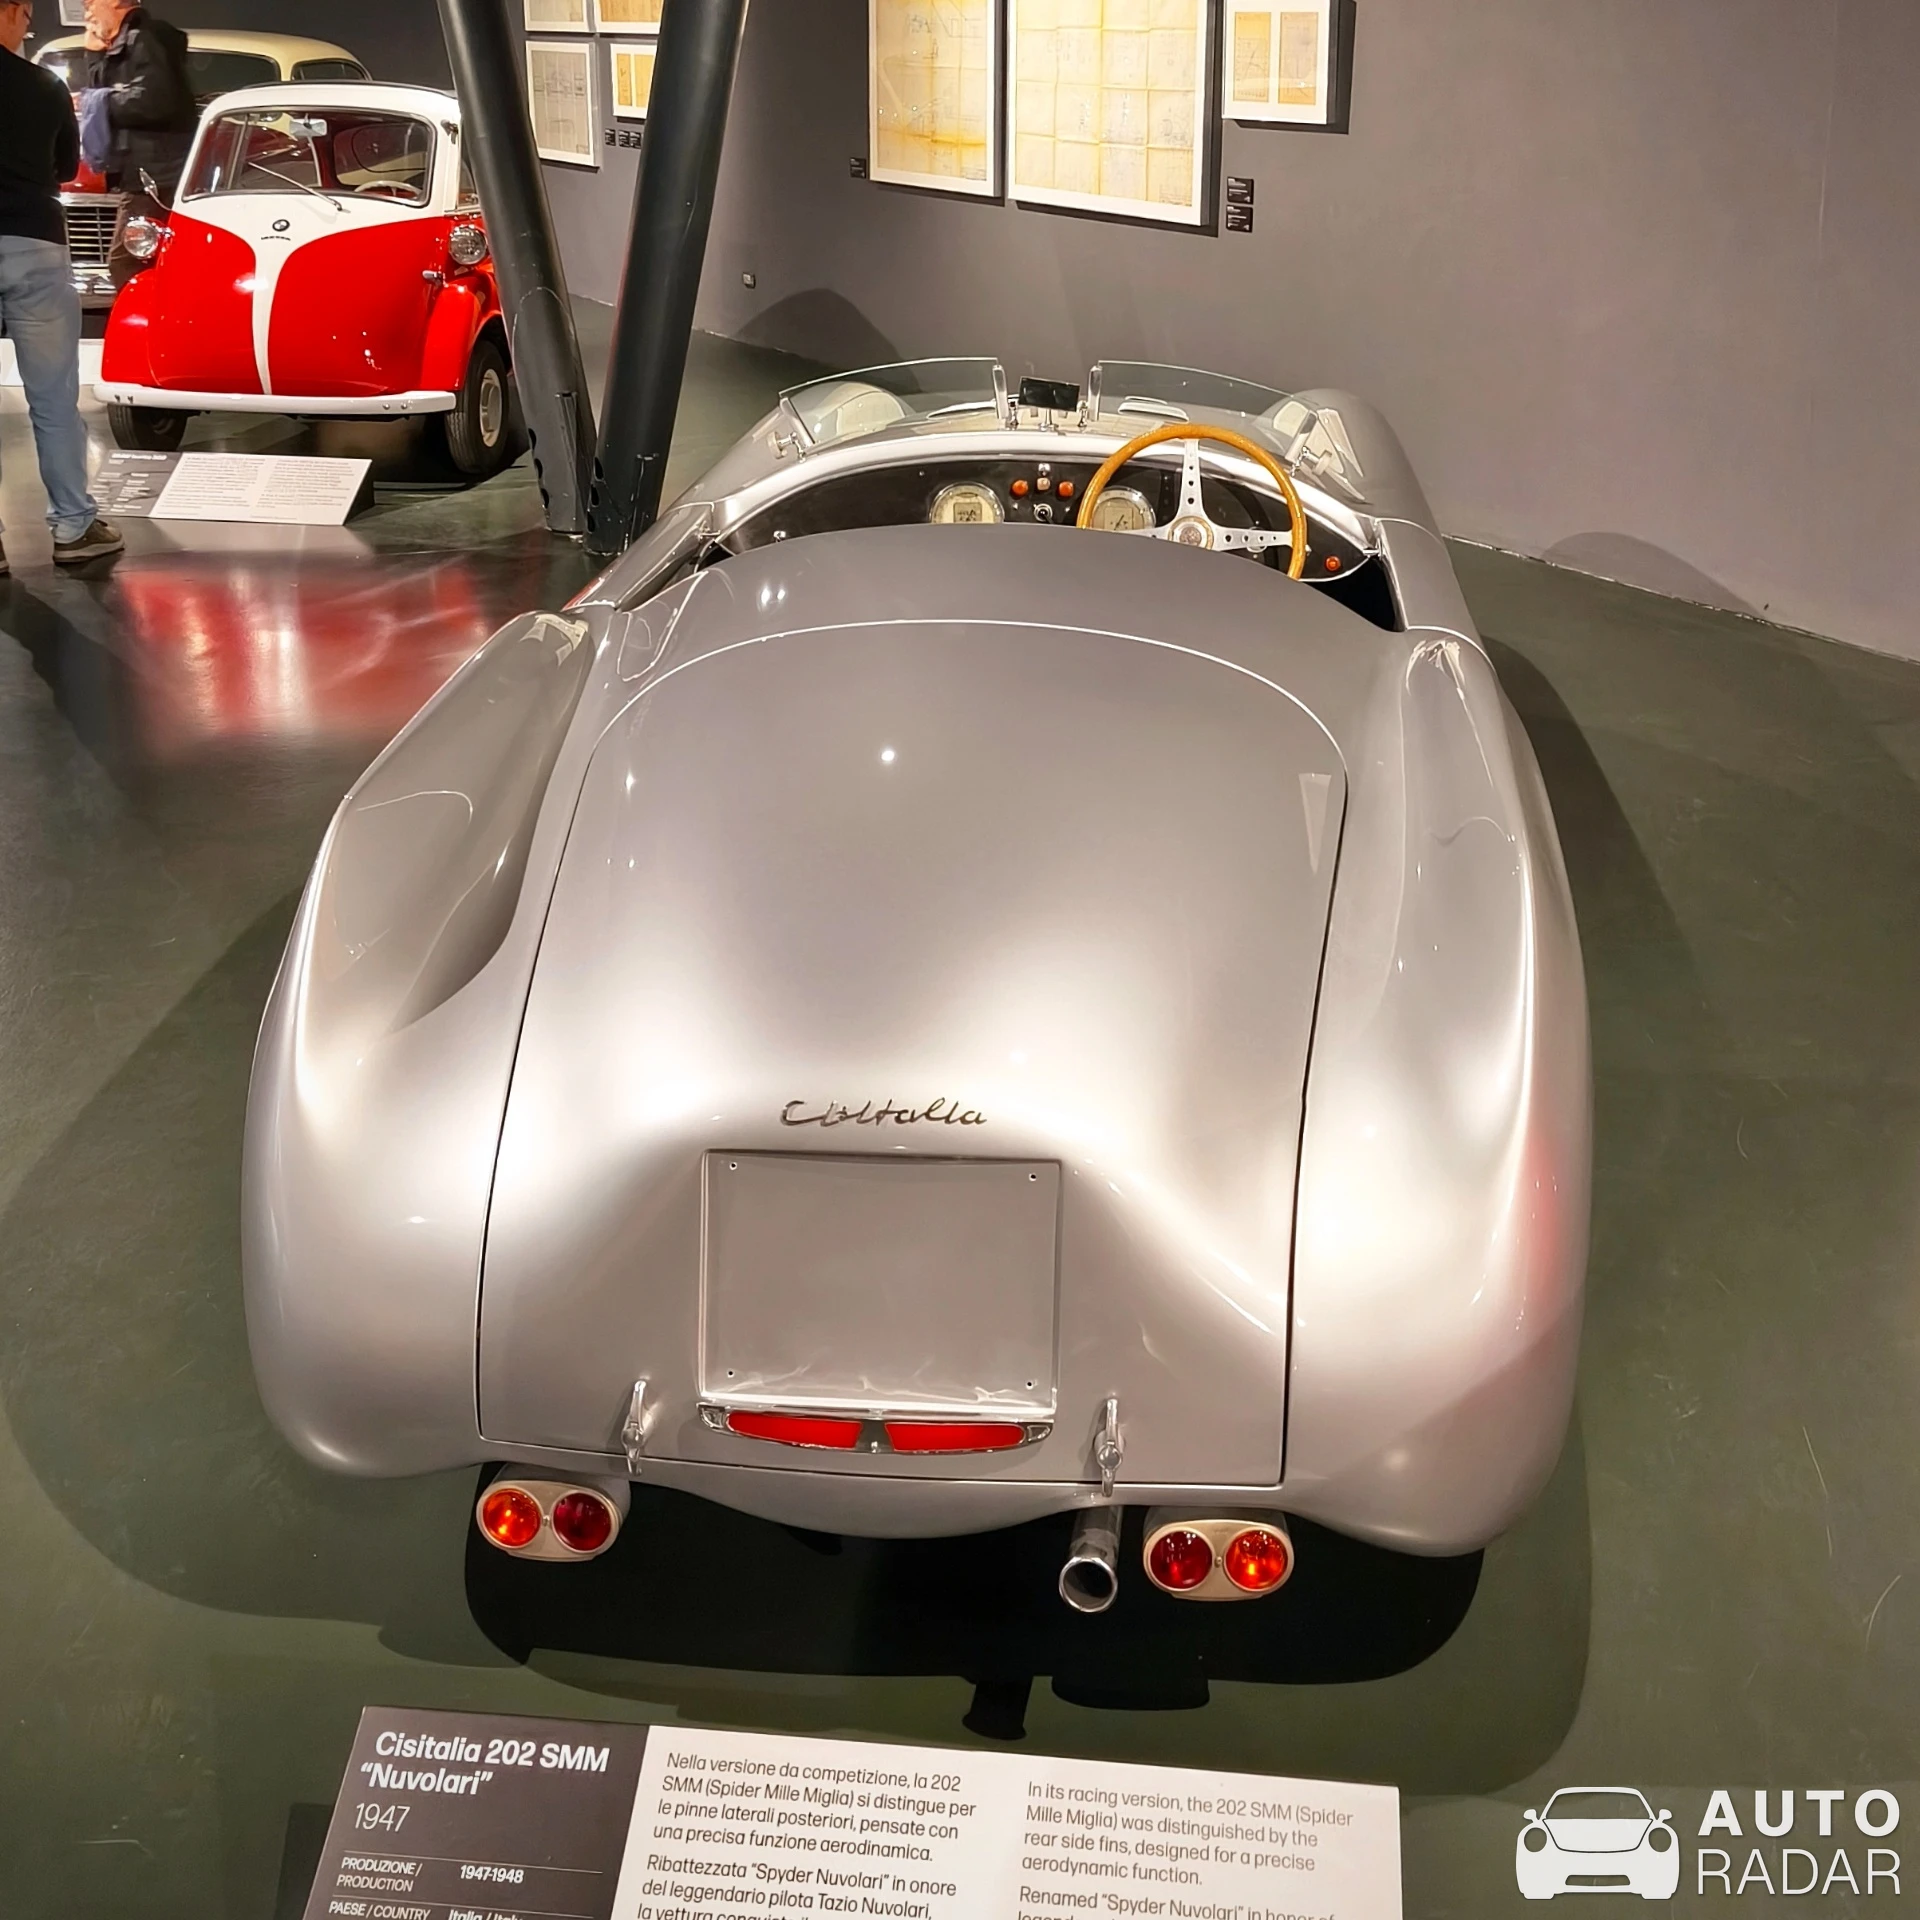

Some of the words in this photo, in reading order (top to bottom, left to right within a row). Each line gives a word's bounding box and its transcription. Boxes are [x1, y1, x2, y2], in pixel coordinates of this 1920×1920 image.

[376, 1731, 482, 1763] Cisitalia
[484, 1739, 536, 1767] 202
[539, 1743, 610, 1772] SMM
[360, 1762, 494, 1795] “Nuvolari”
[667, 1752, 706, 1770] Nella
[710, 1758, 776, 1776] versione
[779, 1762, 799, 1778] da
[802, 1767, 910, 1789] competizione,
[914, 1772, 927, 1789] la
[931, 1774, 961, 1792] 202
[662, 1775, 703, 1793] SMM
[705, 1778, 762, 1798] (Spider
[764, 1783, 800, 1801] Mille
[803, 1786, 854, 1808] Miglia)
[857, 1792, 870, 1807] si
[873, 1793, 946, 1816] distingue
[949, 1803, 977, 1818] per
[1027, 1781, 1042, 1797] In
[1045, 1783, 1065, 1800] its
[1068, 1787, 1118, 1808] racing
[1121, 1792, 1183, 1813] version,
[1187, 1796, 1213, 1813] the
[1216, 1798, 1247, 1816] 202
[1250, 1801, 1292, 1820] SMM
[1295, 1805, 1353, 1827] (Spider
[354, 1802, 410, 1832] 1947
[658, 1799, 672, 1814] le
[674, 1801, 718, 1819] pinne
[721, 1803, 775, 1823] laterali
[777, 1812, 856, 1832] posteriori,
[859, 1818, 925, 1836] pensate
[929, 1824, 959, 1839] con
[1026, 1804, 1062, 1823] Mille
[1066, 1808, 1118, 1831] Miglia)
[1121, 1817, 1154, 1832] was
[1157, 1817, 1265, 1842] distinguished
[1269, 1827, 1288, 1848] by
[1292, 1830, 1318, 1847] the
[653, 1825, 683, 1840] una
[685, 1828, 745, 1845] precisa
[749, 1830, 817, 1851] funzione
[820, 1838, 933, 1861] aerodinamica.
[1024, 1831, 1058, 1847] rear
[1061, 1833, 1095, 1851] side
[1099, 1835, 1132, 1856] fins,
[1135, 1839, 1210, 1862] designed
[1214, 1846, 1237, 1863] for
[1240, 1852, 1250, 1865] a
[1254, 1853, 1315, 1871] precise
[336, 1874, 414, 1892] PRODUCTION
[460, 1864, 524, 1884] 1947-1948
[647, 1854, 747, 1878] Ribattezzata
[751, 1862, 813, 1885] “Spyder
[816, 1868, 889, 1890] Nuvolari”
[892, 1875, 906, 1892] in
[909, 1880, 957, 1897] onore
[1022, 1856, 1128, 1878] aerodynamic
[1132, 1862, 1203, 1886] function.
[637, 1902, 652, 1920] la
[642, 1879, 668, 1896] del
[669, 1880, 766, 1905] leggendario
[768, 1889, 814, 1909] pilota
[818, 1892, 858, 1913] Tazio
[861, 1897, 932, 1919] Nuvolari,
[1019, 1885, 1098, 1909] Renamed
[1102, 1893, 1166, 1916] “Spyder
[1248, 1906, 1261, 1920] in
